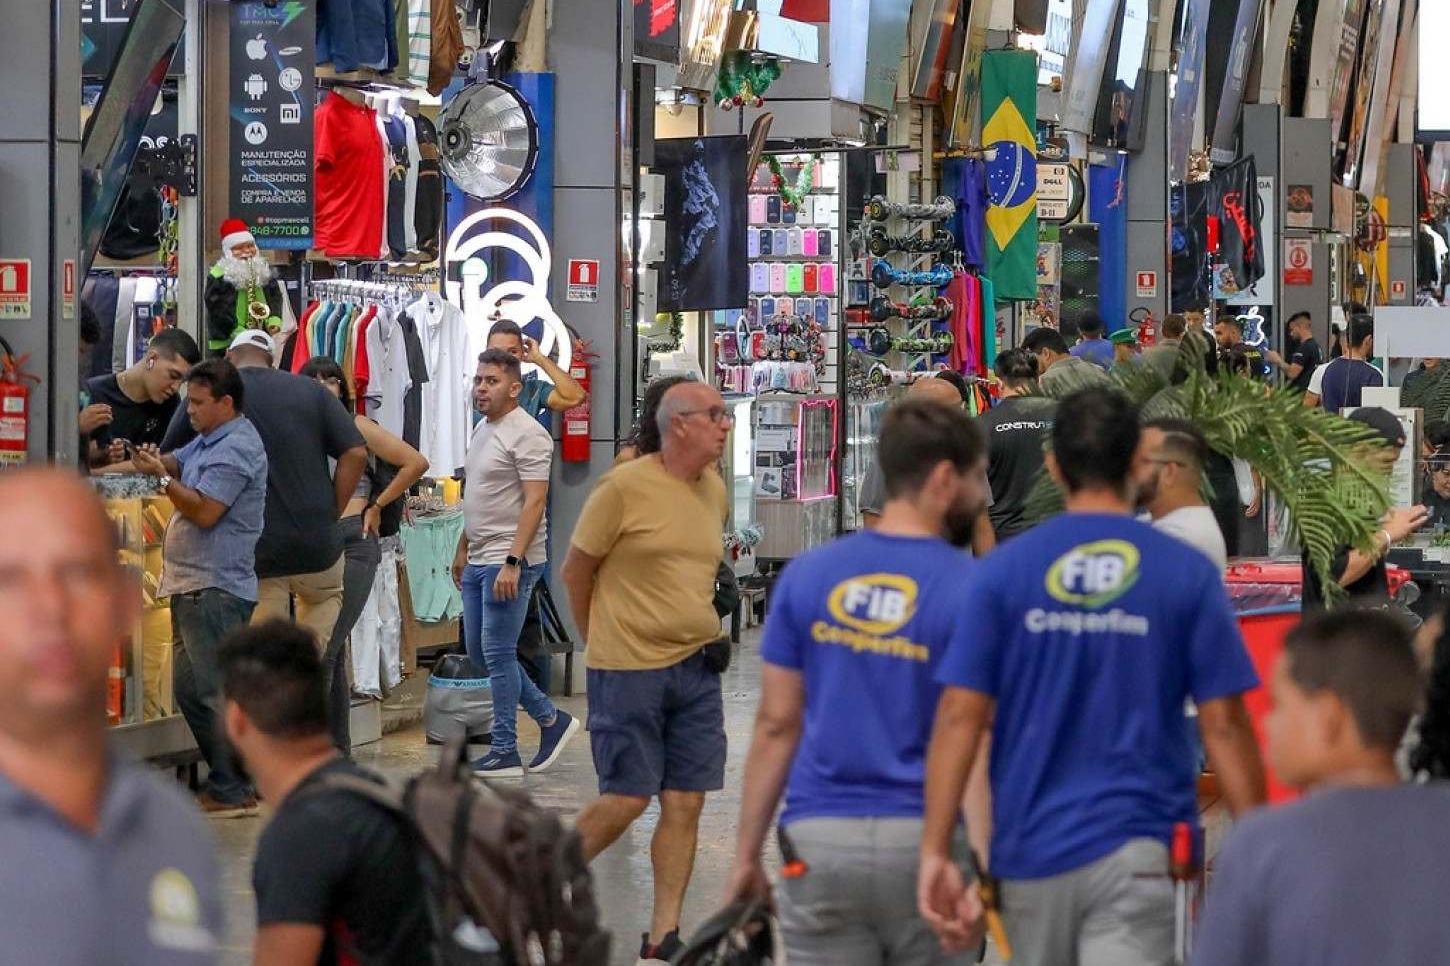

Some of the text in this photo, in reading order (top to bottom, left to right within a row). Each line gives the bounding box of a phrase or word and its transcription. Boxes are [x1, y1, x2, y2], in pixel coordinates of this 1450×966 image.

[241, 149, 307, 160] MANUTENÇÃO
[241, 159, 306, 167] ESPECIALIZADA
[241, 172, 307, 183] ACESSÓRIOS
[241, 195, 307, 203] DE APARELHOS
[1062, 550, 1124, 593] FIB
[843, 583, 908, 622] FIB
